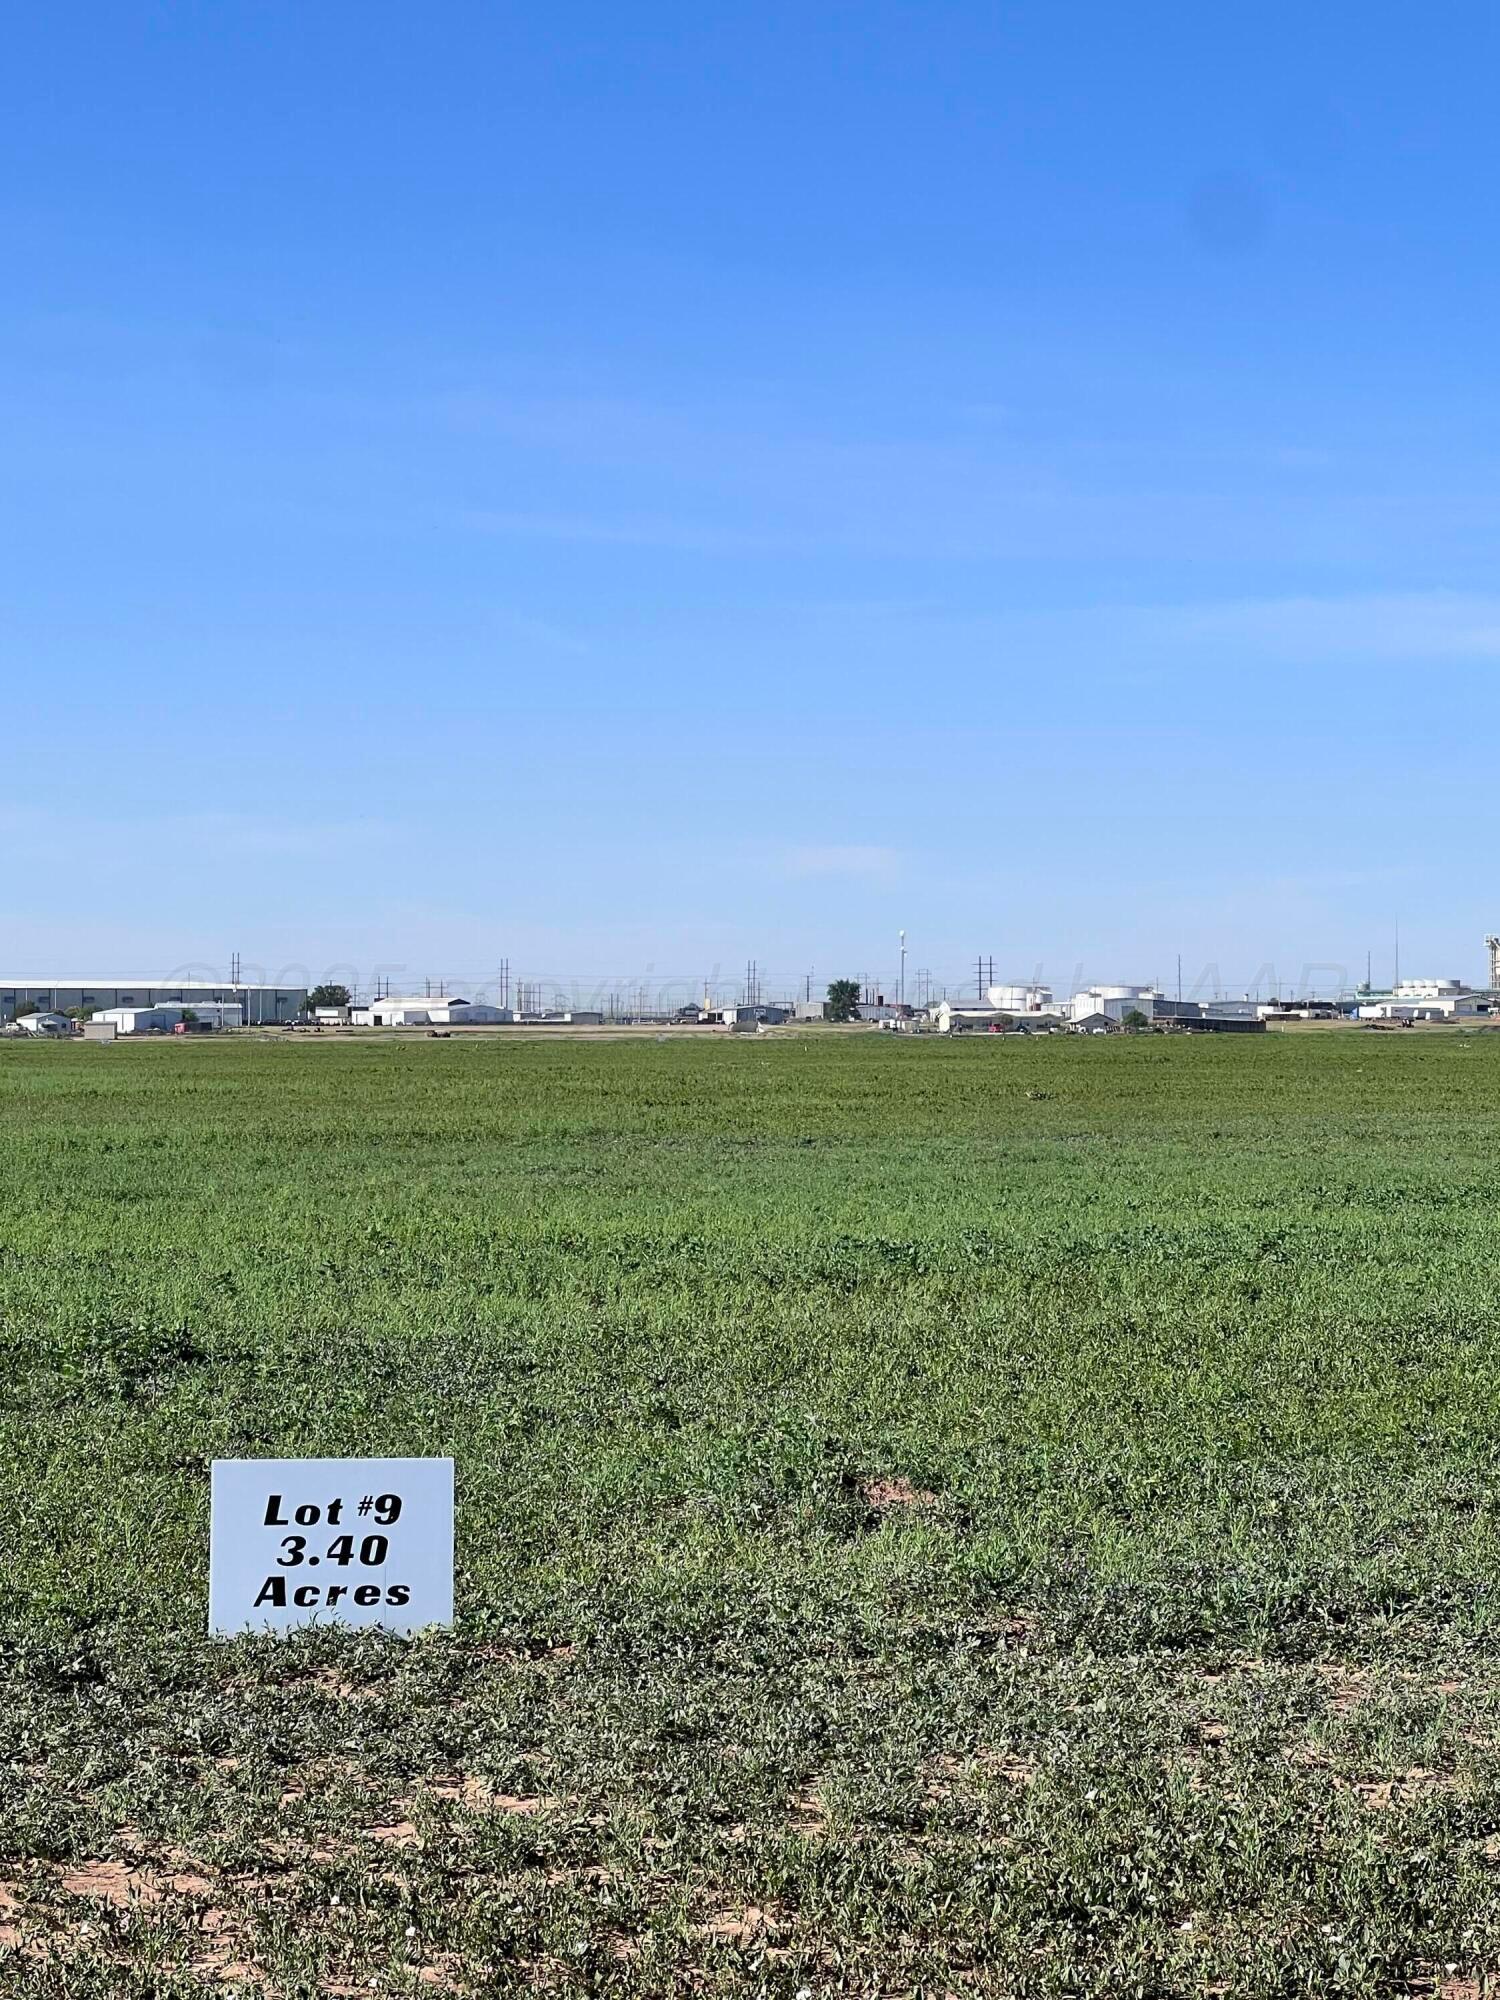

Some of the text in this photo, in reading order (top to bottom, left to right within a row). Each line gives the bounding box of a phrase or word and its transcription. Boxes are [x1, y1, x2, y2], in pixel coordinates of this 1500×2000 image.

[263, 1493, 403, 1526] Lot #9
[276, 1535, 389, 1567] 3.40
[253, 1575, 411, 1608] Acres
